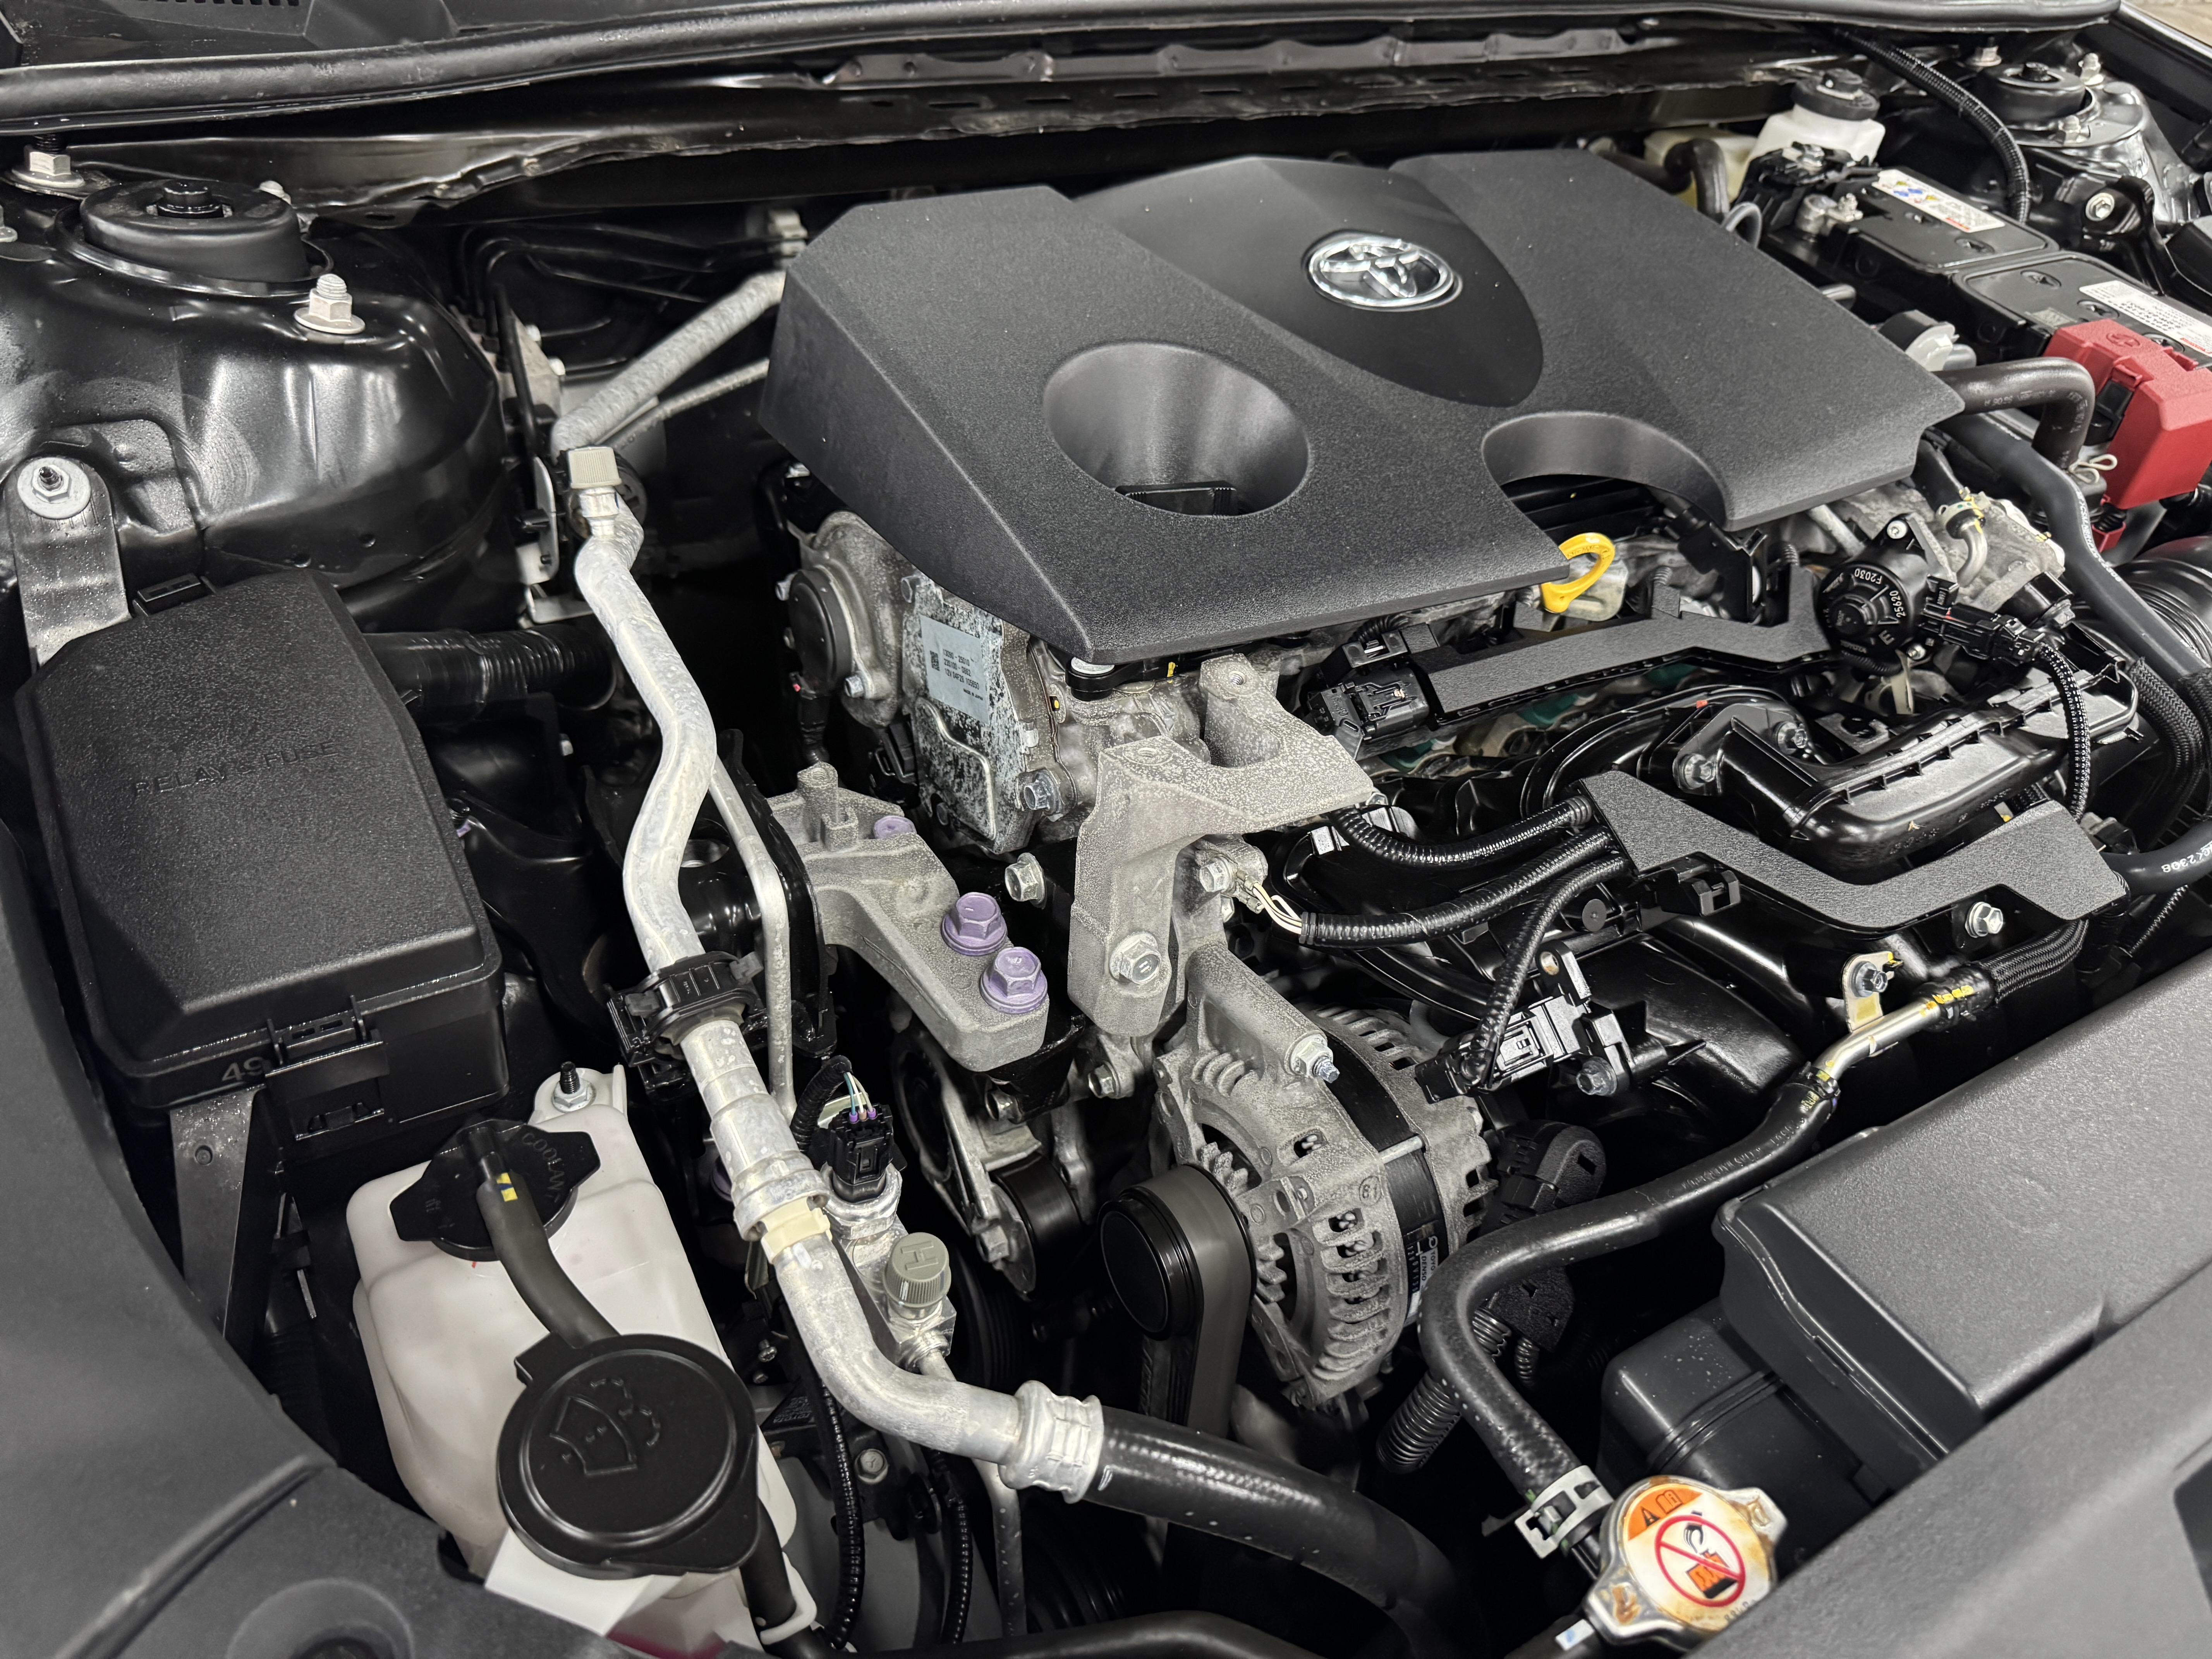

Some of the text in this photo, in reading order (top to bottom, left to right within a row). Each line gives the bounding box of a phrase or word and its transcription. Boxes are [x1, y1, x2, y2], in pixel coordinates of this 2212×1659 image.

[1854, 568, 1883, 585] F2030
[1889, 591, 1906, 618] 25620
[132, 765, 226, 797] RELAY
[263, 742, 339, 769] FUSE
[522, 1132, 565, 1203] COOLANT
[900, 1240, 939, 1271] H
